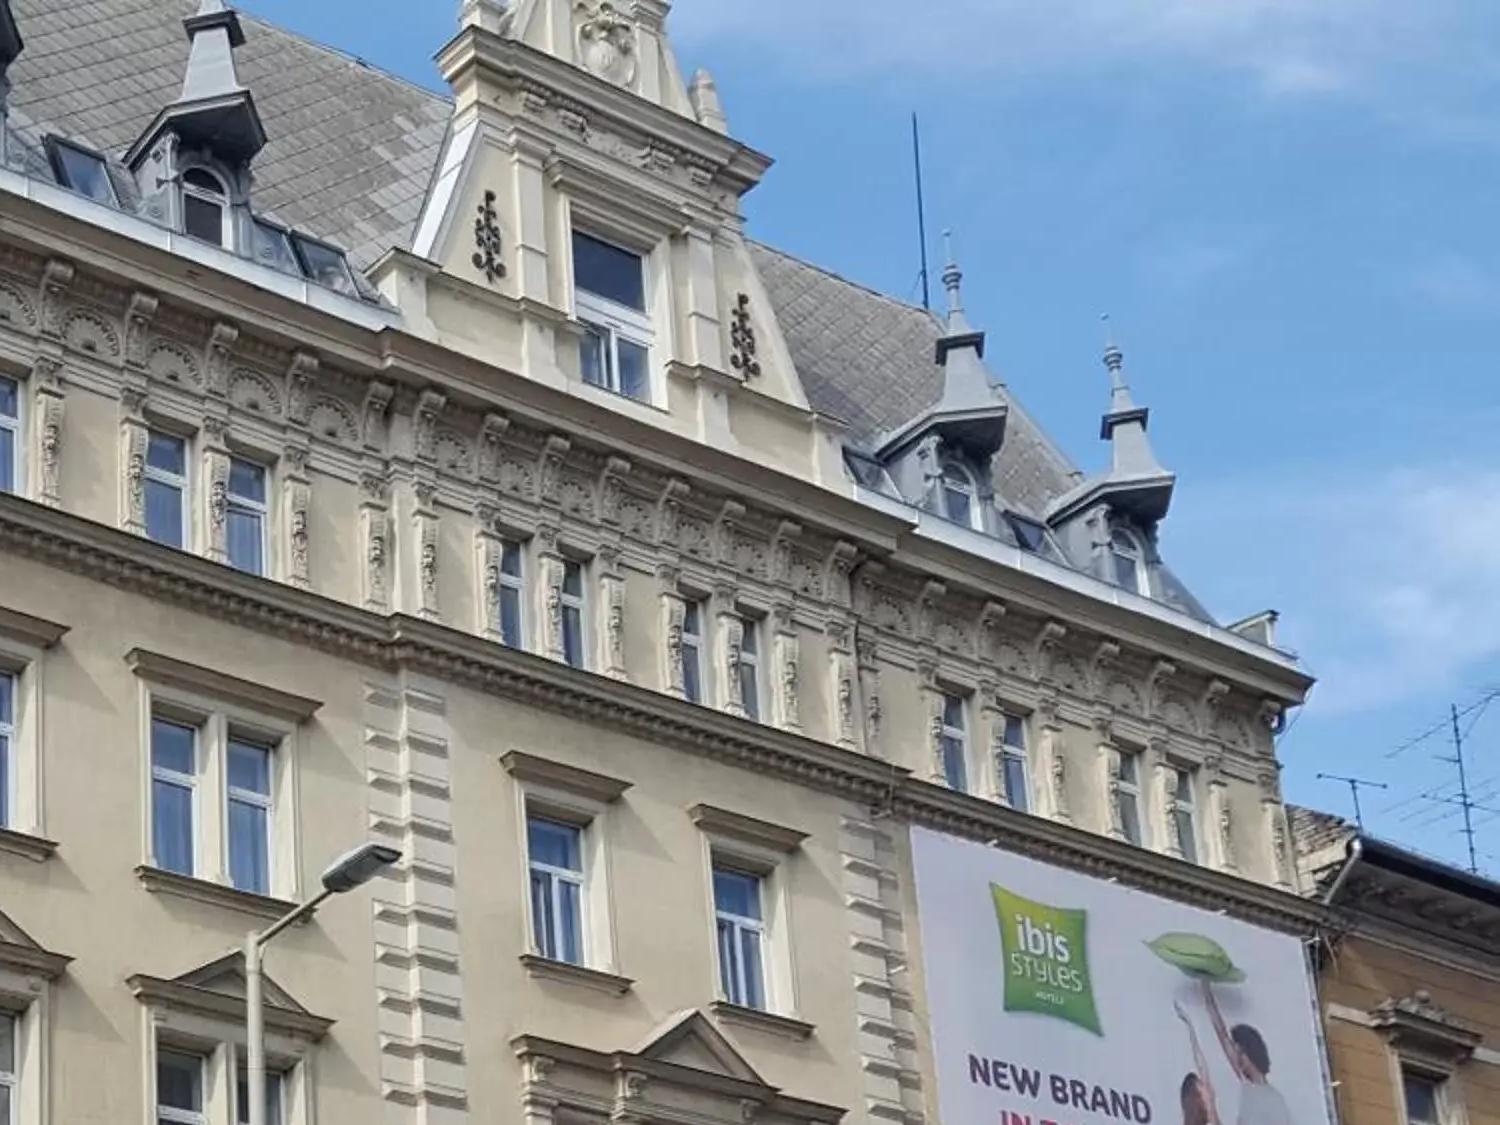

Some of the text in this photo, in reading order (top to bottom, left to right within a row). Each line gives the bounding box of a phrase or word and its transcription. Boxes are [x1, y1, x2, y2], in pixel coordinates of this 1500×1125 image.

[1015, 914, 1070, 964] ibis
[969, 1053, 1152, 1125] NEW BRAND
